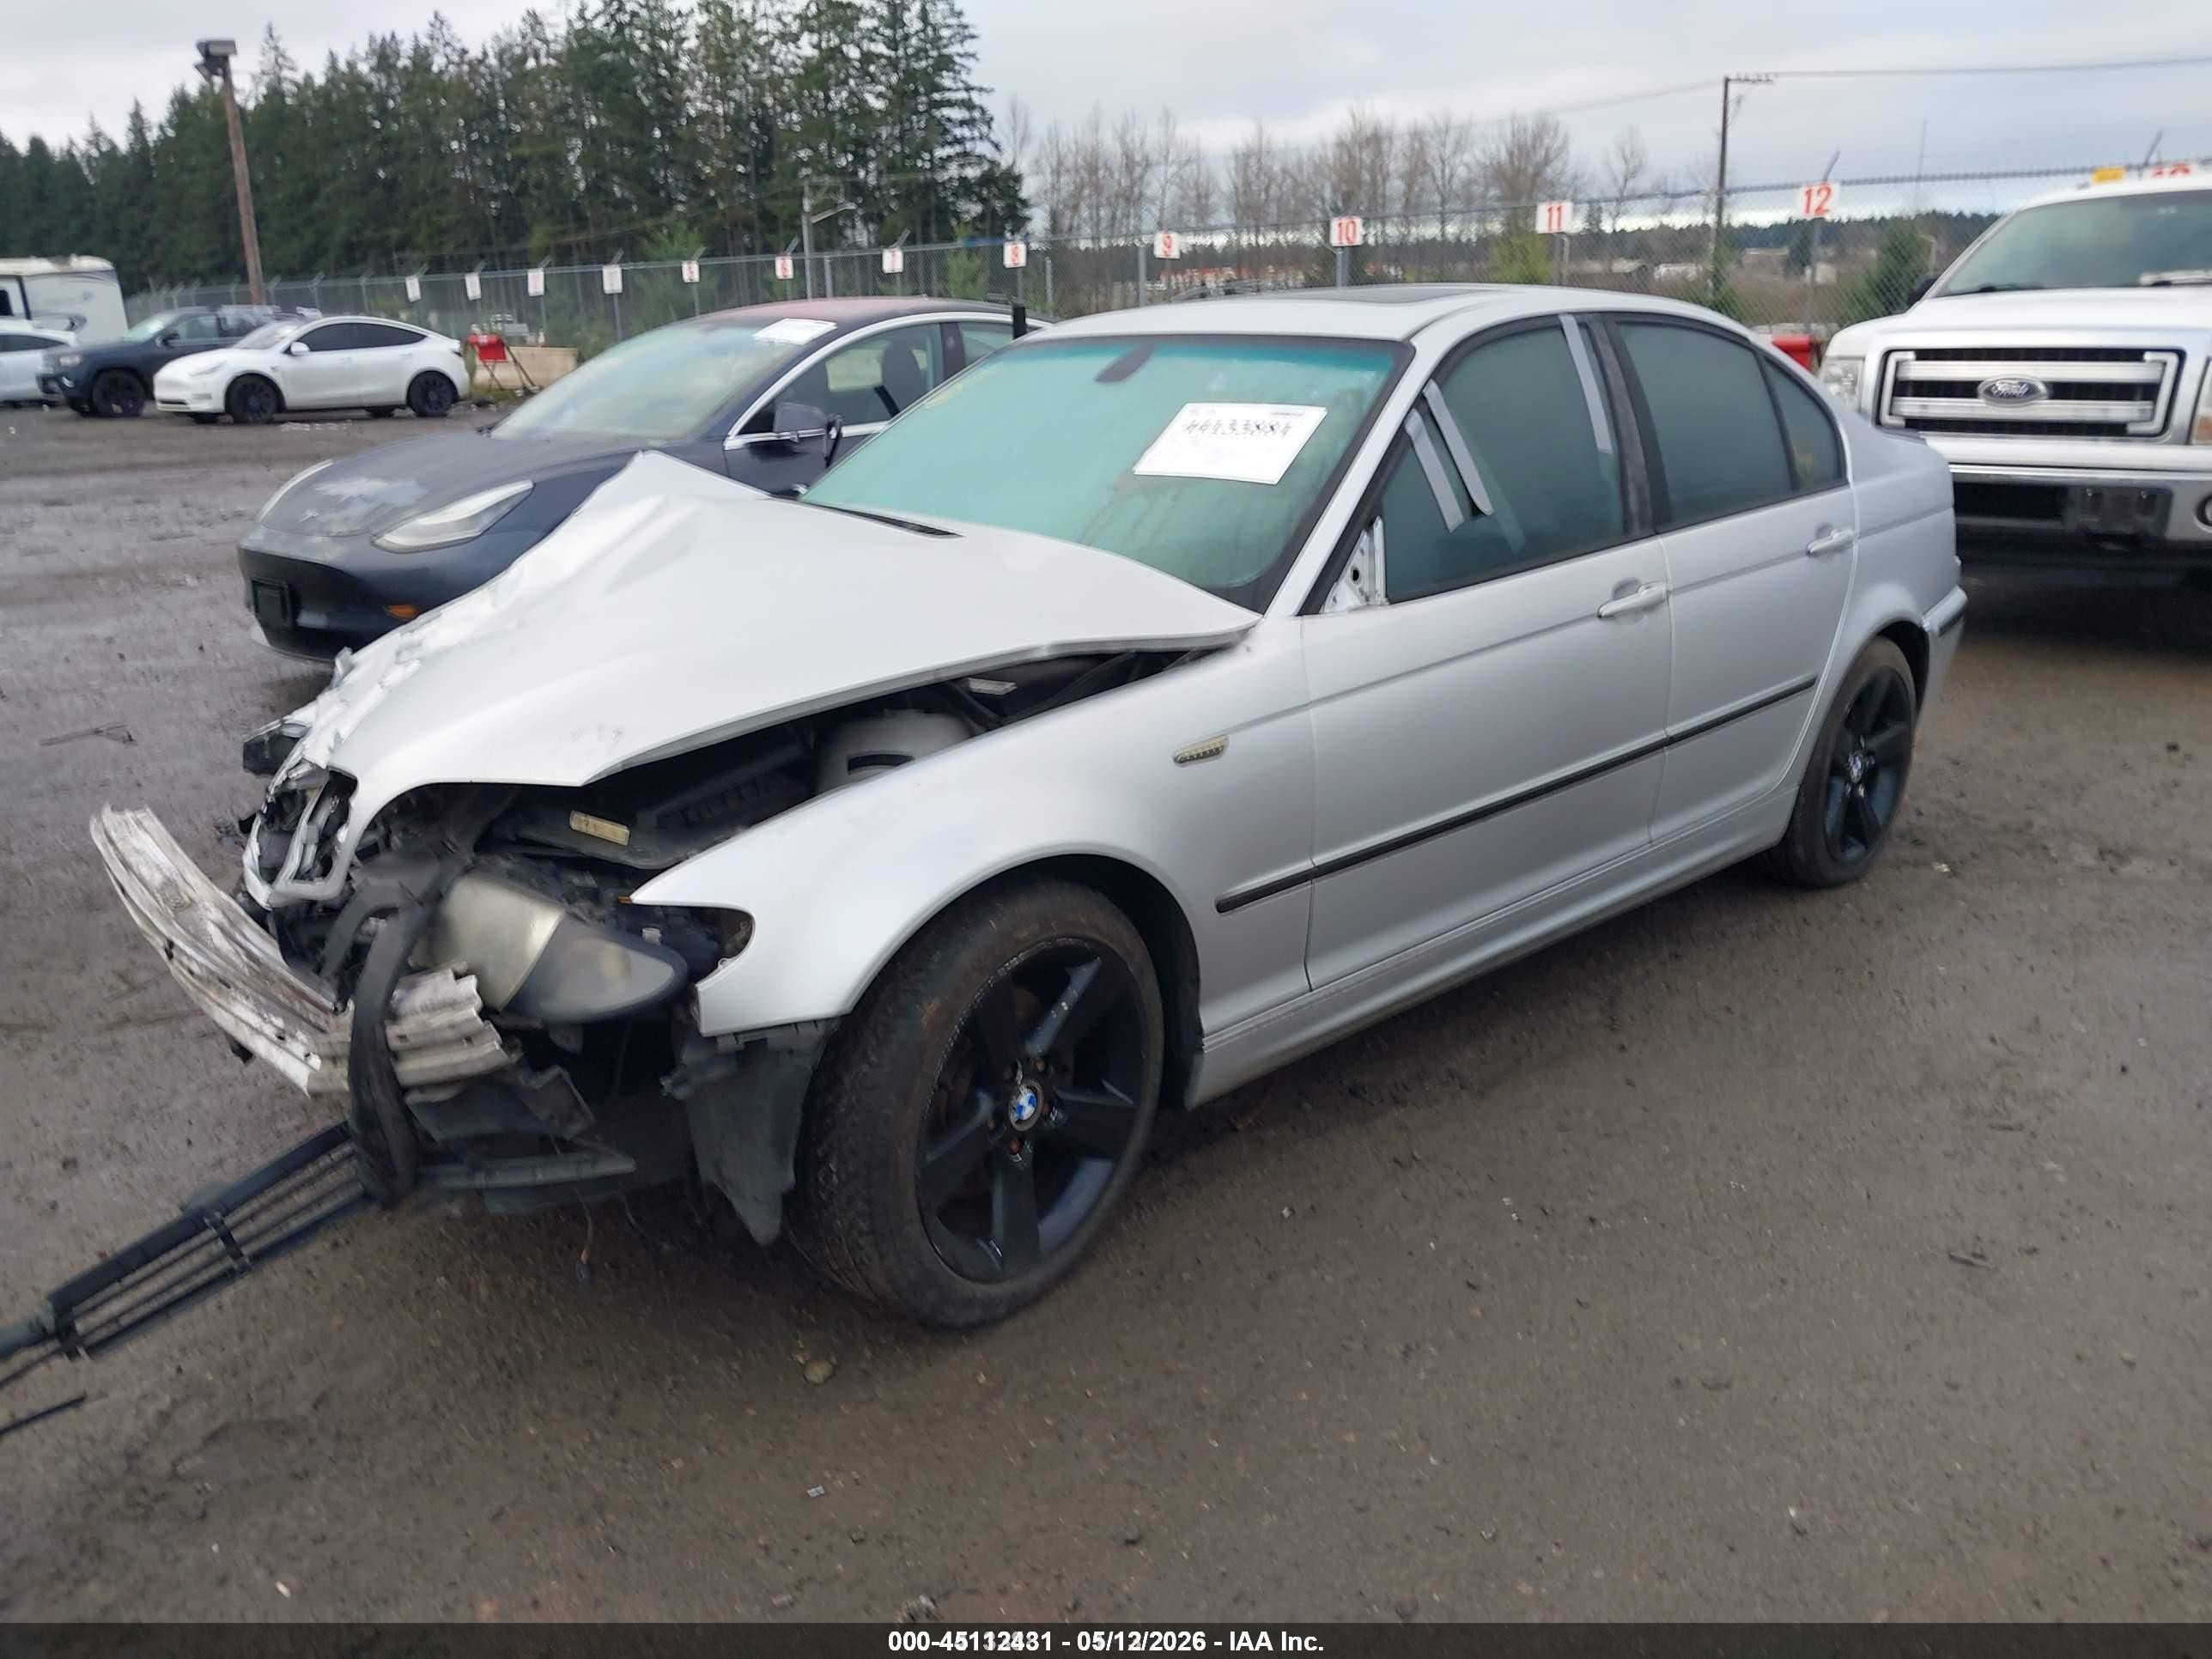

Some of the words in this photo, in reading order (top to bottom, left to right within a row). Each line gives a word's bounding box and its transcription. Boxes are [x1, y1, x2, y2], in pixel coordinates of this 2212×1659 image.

[1804, 184, 1832, 216] 12
[1547, 205, 1563, 232] 11
[1337, 221, 1355, 245] 10
[1990, 380, 2029, 398] Ford
